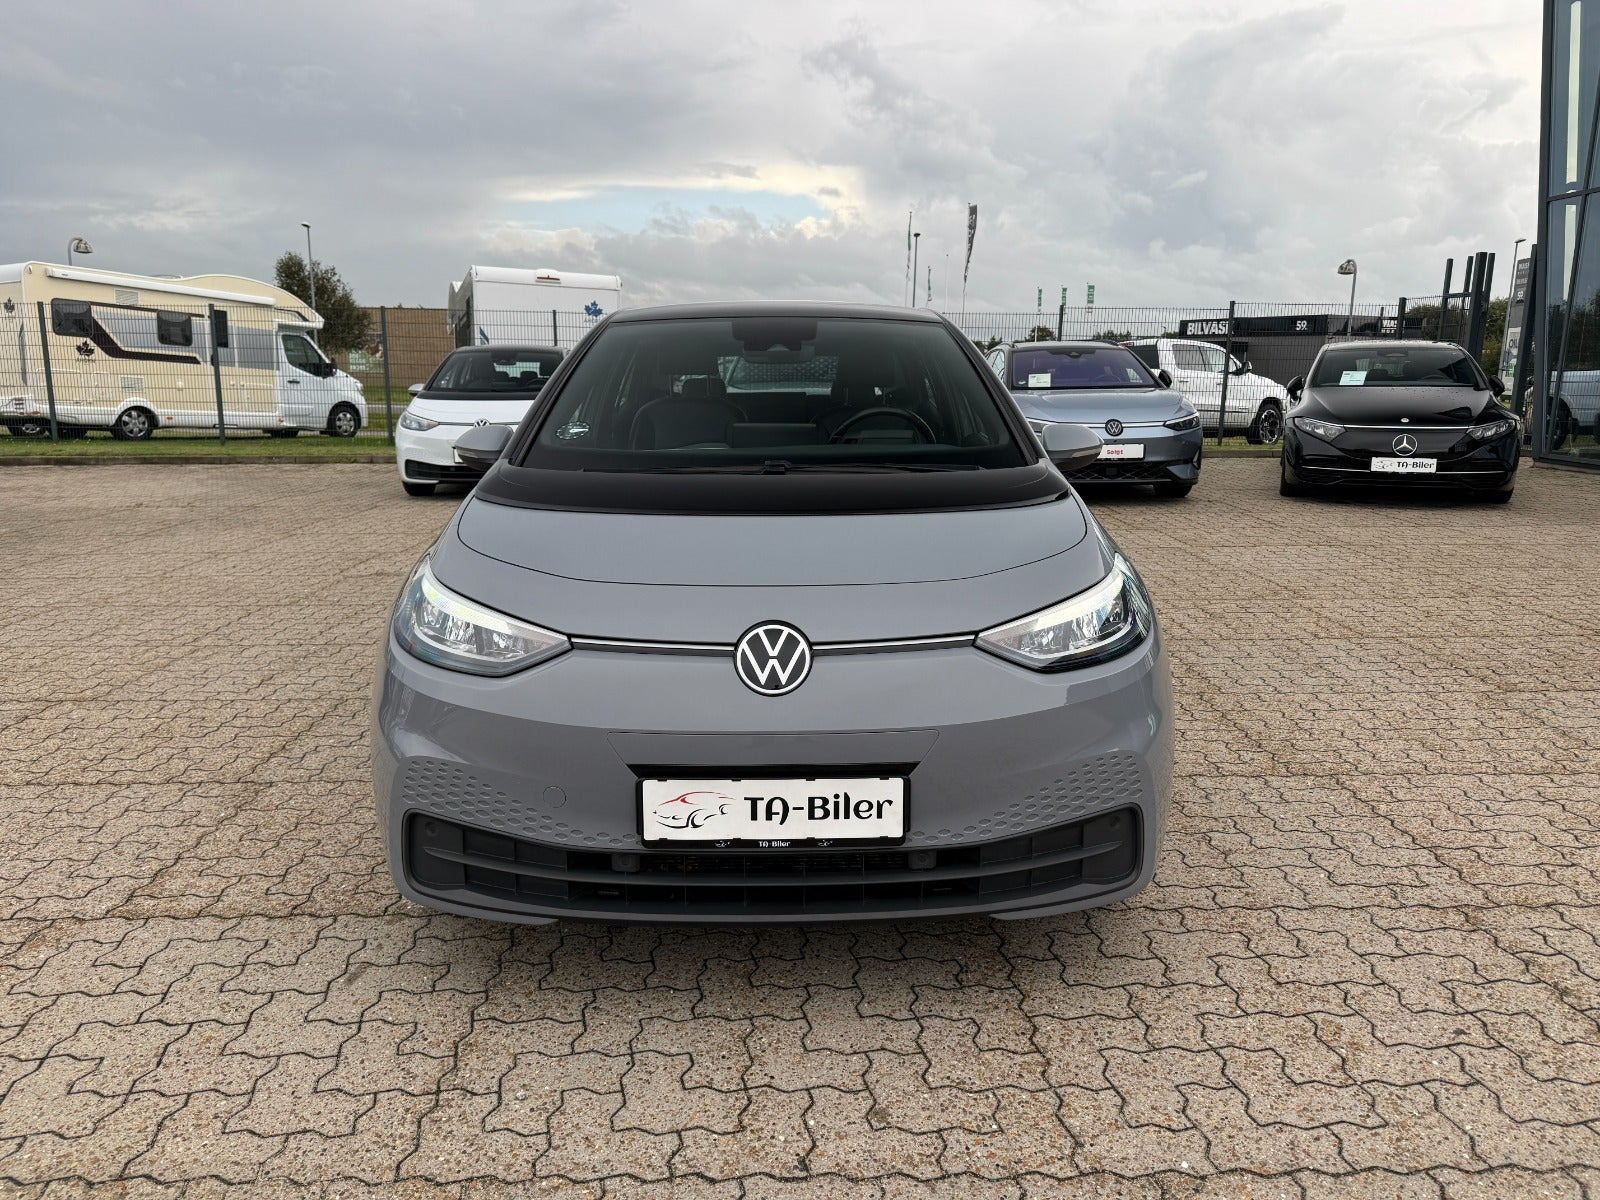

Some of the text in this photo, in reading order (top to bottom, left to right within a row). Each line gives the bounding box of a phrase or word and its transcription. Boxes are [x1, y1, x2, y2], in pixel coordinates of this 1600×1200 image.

[1396, 461, 1435, 469] TA-Biler
[736, 624, 811, 694] VW
[743, 791, 894, 826] TA-Biler
